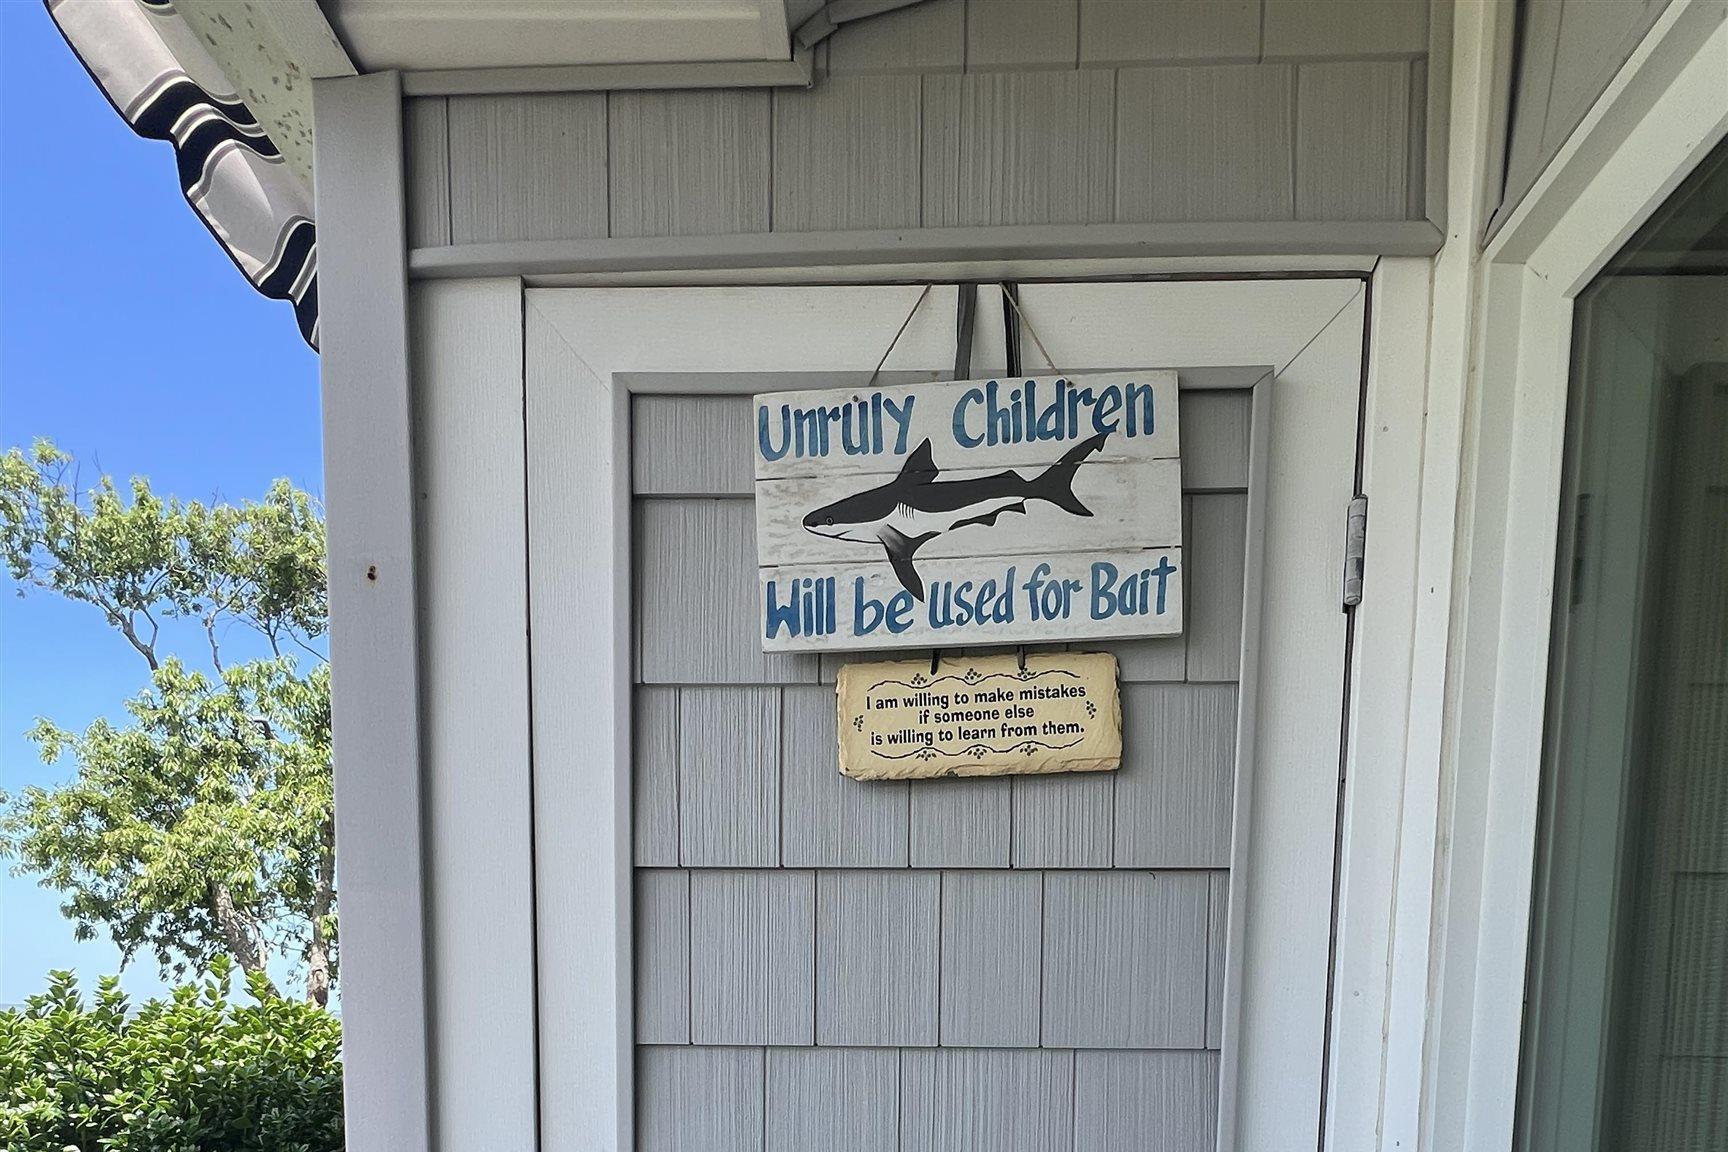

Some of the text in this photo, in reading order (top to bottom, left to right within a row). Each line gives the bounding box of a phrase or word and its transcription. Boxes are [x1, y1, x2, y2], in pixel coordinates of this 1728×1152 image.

[951, 380, 1154, 448] Children
[766, 556, 1178, 640] Will be used for Bait
[866, 684, 1086, 710] I am willing to make mistakes
[919, 705, 1035, 724] if someone else
[870, 721, 1085, 745] is willing to learn from them.
